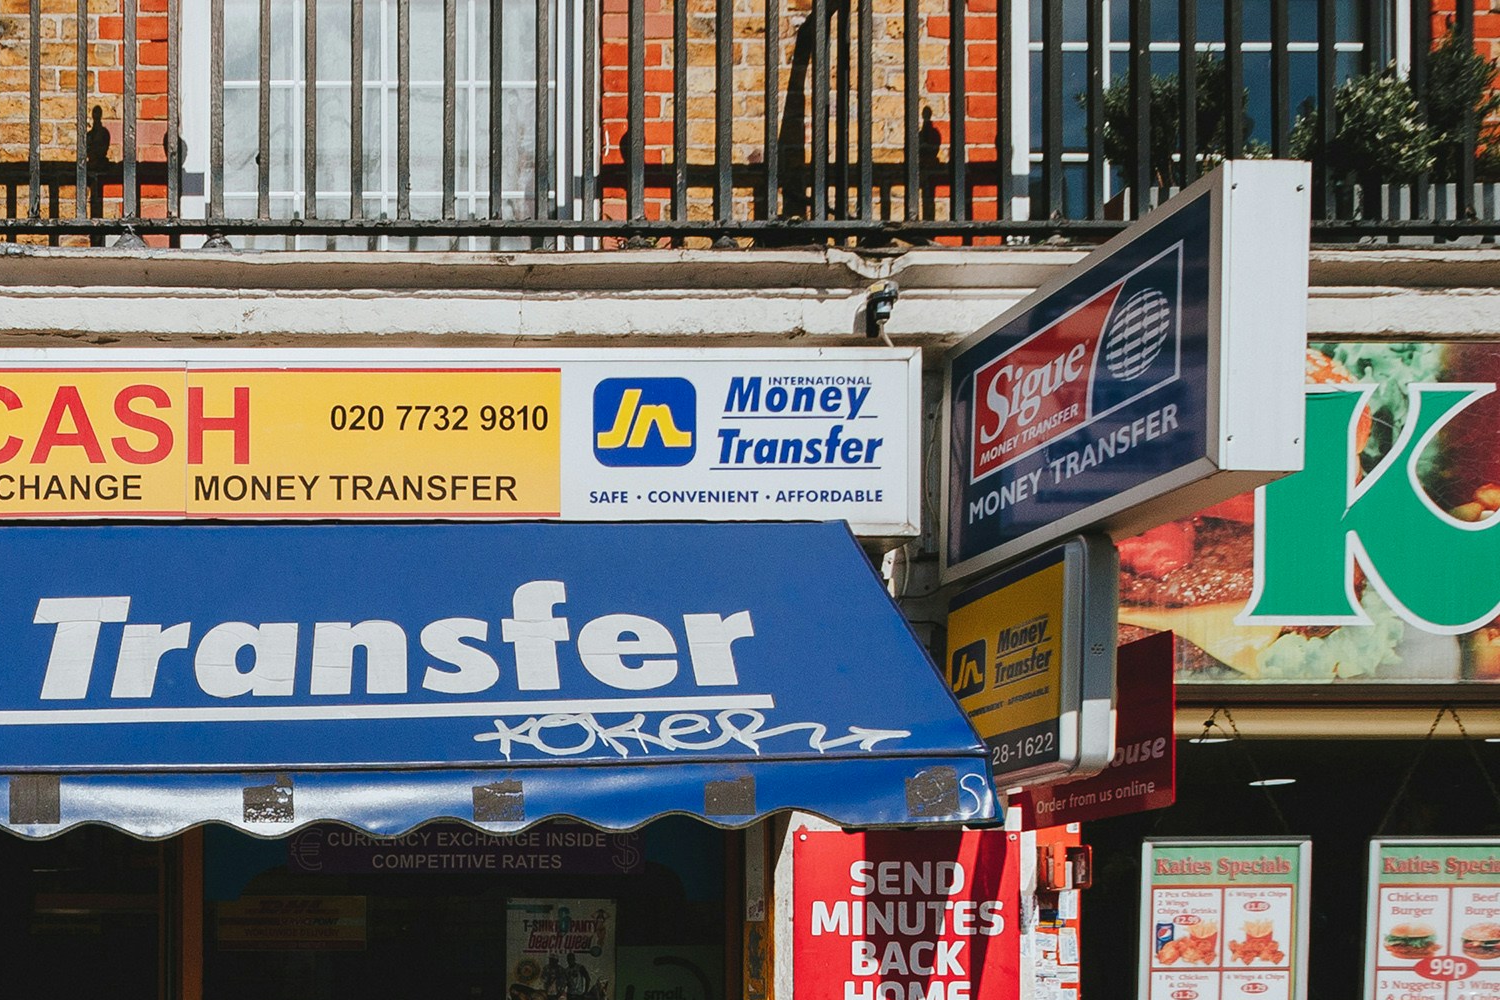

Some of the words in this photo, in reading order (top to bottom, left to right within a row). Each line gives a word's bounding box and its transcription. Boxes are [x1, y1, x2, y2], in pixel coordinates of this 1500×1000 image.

[767, 376, 873, 387] INTERNATIONAL
[980, 341, 1087, 445] Sigue
[723, 376, 873, 420] Money
[329, 404, 385, 432] 020
[396, 404, 468, 432] 7732
[479, 404, 550, 432] 9810
[717, 424, 884, 465] Transfer
[979, 434, 1019, 467] MONEY
[1022, 402, 1079, 445] TRANSFER
[969, 468, 1043, 525] MONEY
[1049, 402, 1180, 485] TRANSFER
[194, 474, 319, 502] MONEY
[328, 474, 518, 502] TRANSFER
[589, 490, 629, 504] SAFE
[647, 490, 759, 503] CONVENIENT
[775, 489, 884, 503] AFFORDABLE
[33, 580, 756, 700] Transfer
[997, 618, 1049, 654] Money
[994, 647, 1053, 685] Transfer
[1036, 796, 1066, 815] Order
[1069, 792, 1097, 809] from
[1099, 789, 1113, 802] us
[1115, 779, 1156, 800] online
[437, 831, 541, 848] EXCHANGE
[546, 831, 607, 848] INSIDE
[372, 853, 497, 870] COMPETITIVE
[501, 853, 563, 870] RATES
[1155, 856, 1213, 876] Katies
[1217, 855, 1293, 881] Specials
[1383, 856, 1442, 875] Katies
[849, 859, 966, 898] SEND
[1387, 891, 1439, 903] Chicken
[1391, 906, 1434, 919] Burger
[811, 900, 1005, 938] MINUTES
[850, 939, 966, 977] BACK
[1429, 958, 1468, 980] 99p
[1391, 980, 1443, 993] Nuggets
